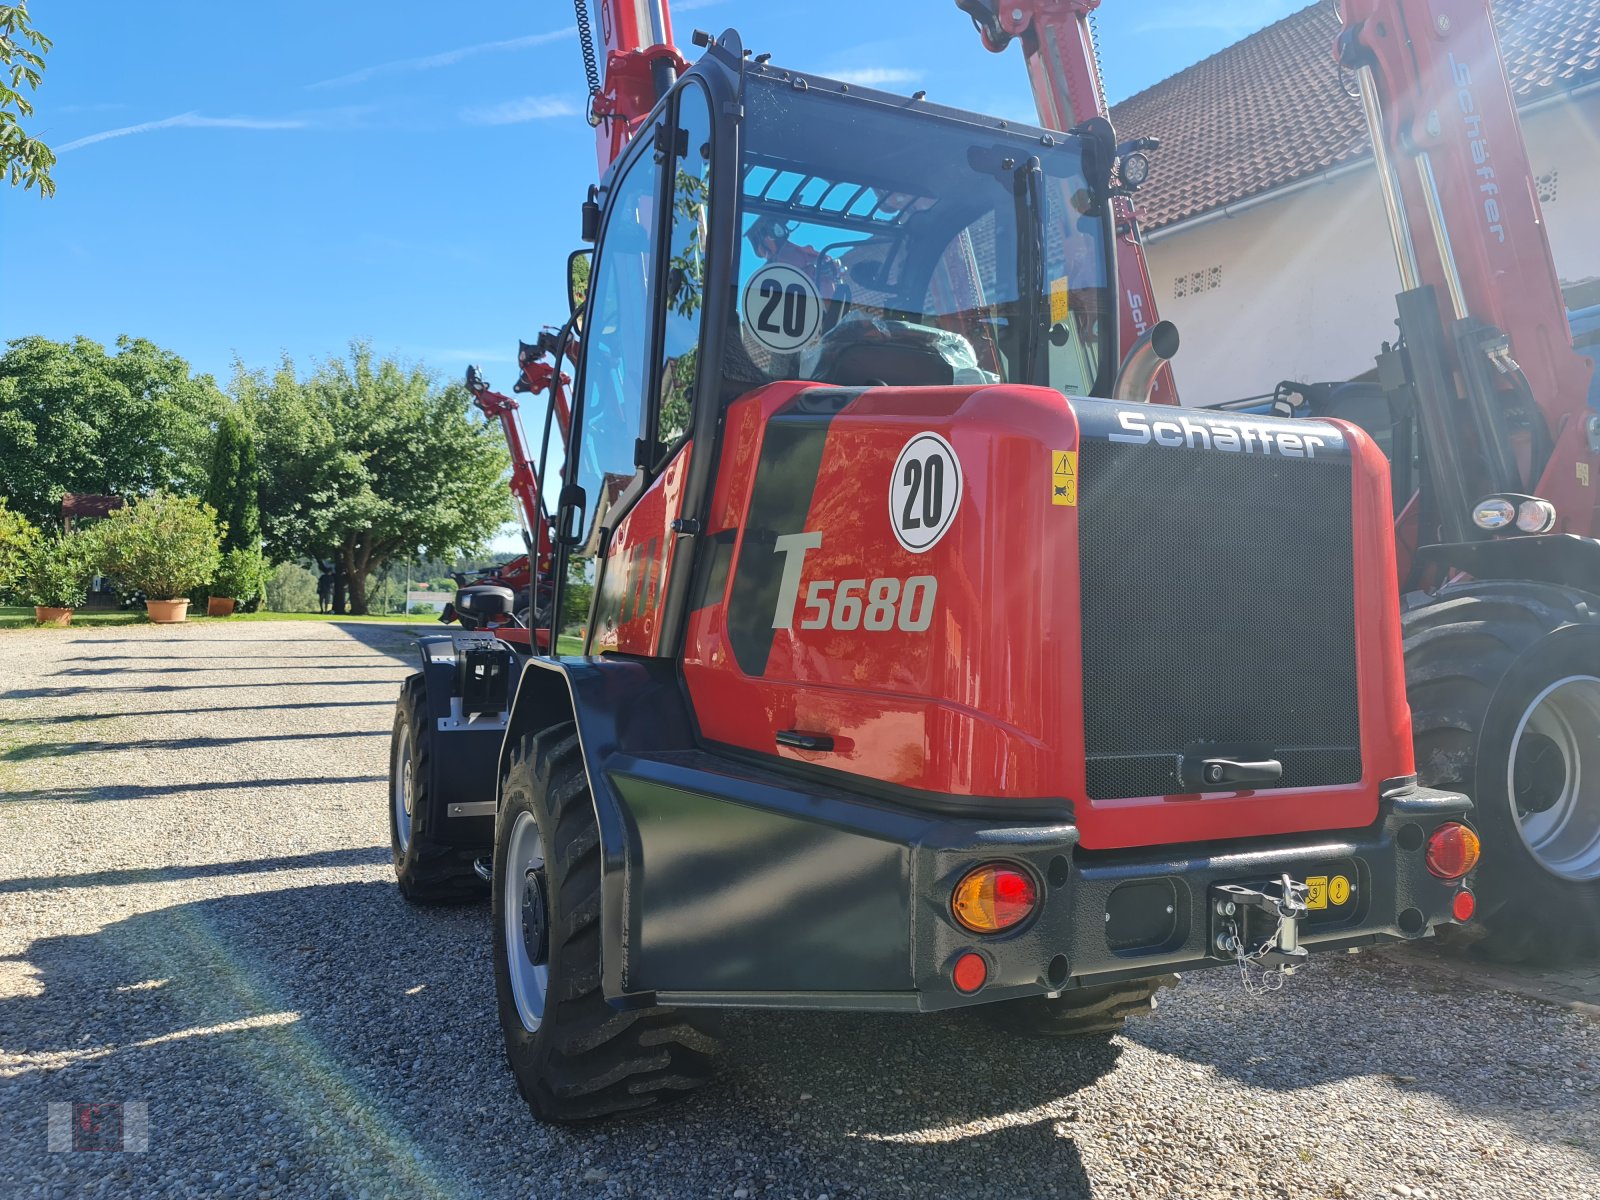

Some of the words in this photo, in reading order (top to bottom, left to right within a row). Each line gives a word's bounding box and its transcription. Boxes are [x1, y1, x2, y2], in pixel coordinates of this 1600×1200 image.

[1449, 52, 1504, 243] Schäffer
[757, 278, 807, 337] 20
[902, 454, 944, 531] 20
